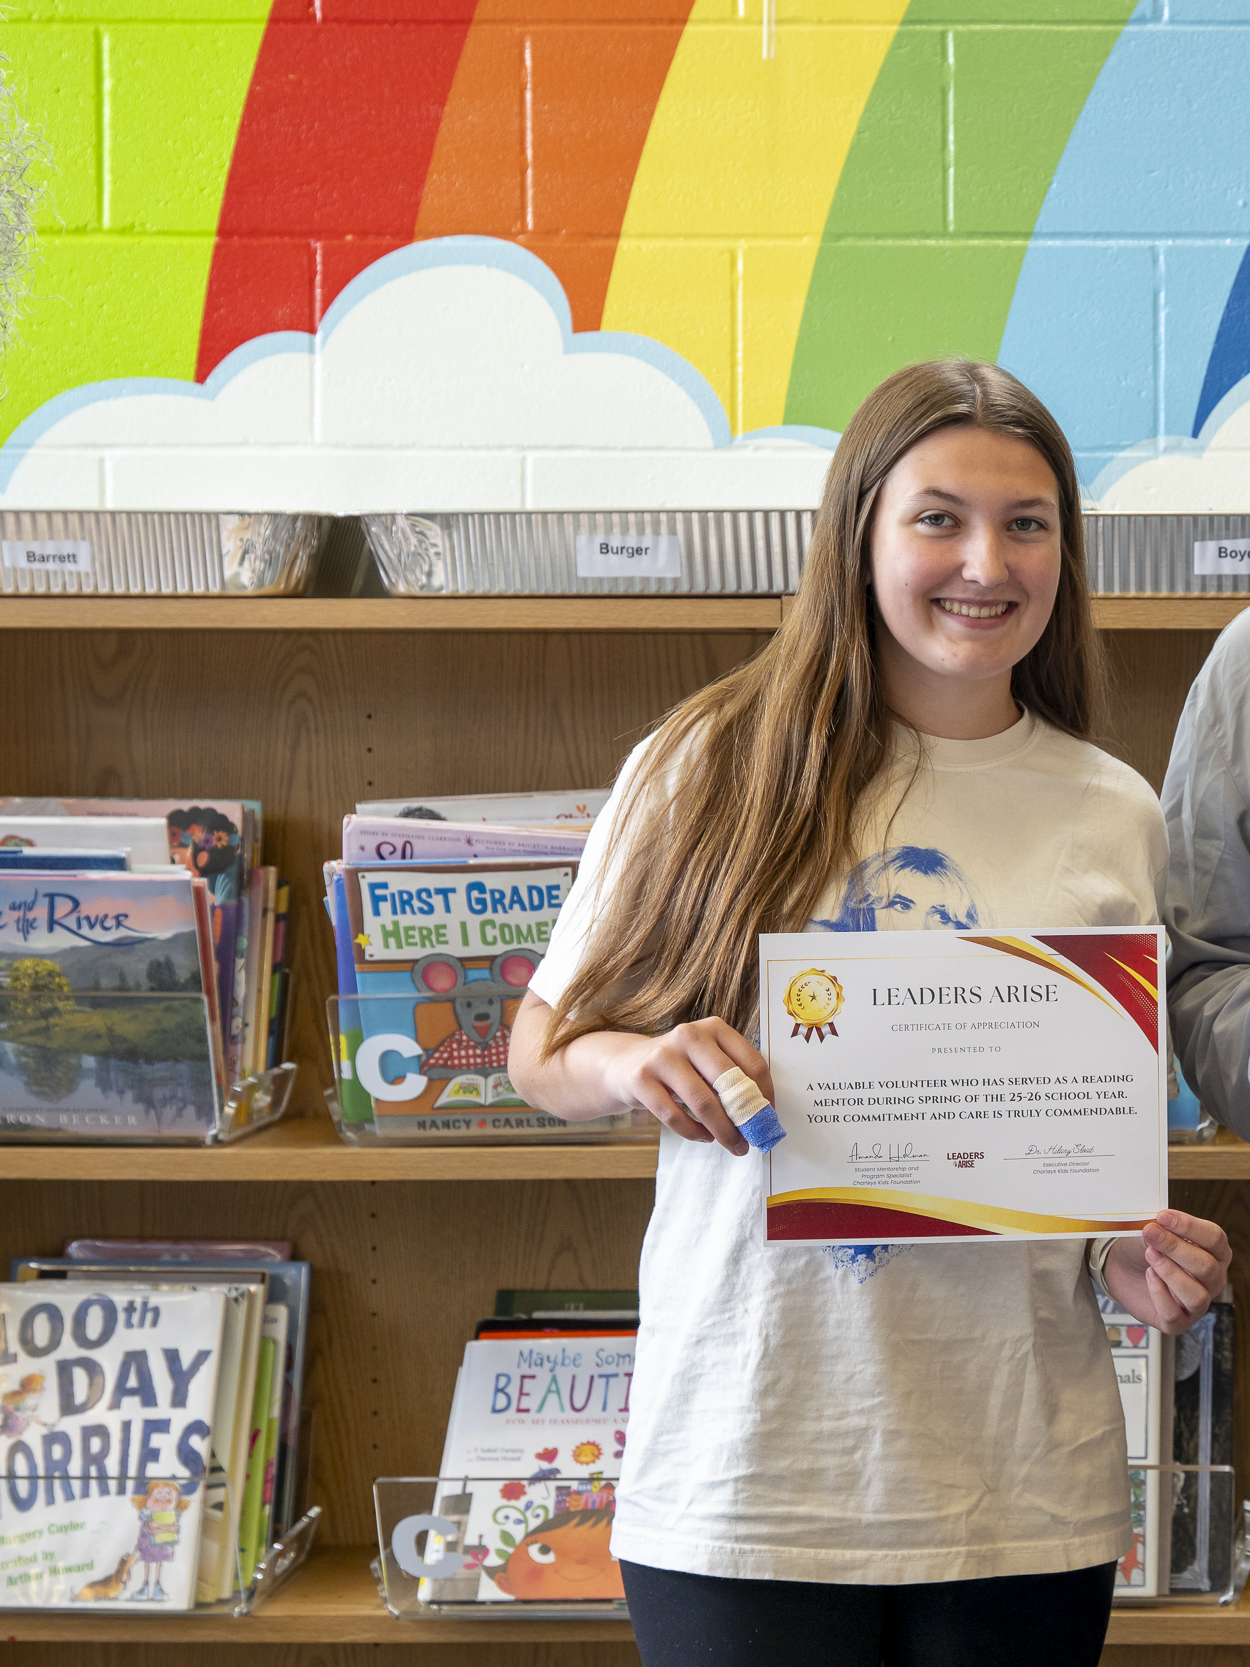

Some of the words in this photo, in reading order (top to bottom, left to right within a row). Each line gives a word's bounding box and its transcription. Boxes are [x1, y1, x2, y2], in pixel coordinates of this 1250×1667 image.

[26, 550, 78, 564] Barrett
[599, 543, 649, 558] Burger
[8, 887, 38, 914] and
[367, 881, 456, 917] FIRST
[465, 881, 562, 915] GRADE
[14, 914, 38, 943] the
[42, 892, 158, 946] River
[381, 919, 449, 950] HERE
[459, 921, 469, 947] I
[872, 985, 981, 1005] LEADERS
[989, 984, 1057, 1003] ARISE
[891, 1022, 952, 1031] CERTIFICATE
[954, 1022, 967, 1030] OF
[970, 1020, 1039, 1029] APPRECIATION
[355, 1033, 428, 1101] C
[817, 1081, 874, 1090] VALUABLE
[877, 1079, 947, 1088] VOLUNTEER
[950, 1078, 978, 1086] WHO
[982, 1077, 1004, 1086] HAS
[1007, 1076, 1051, 1085] SERVED
[1053, 1075, 1067, 1084] AS
[1081, 1074, 1133, 1083] READING
[813, 1097, 864, 1107] MENTOR
[867, 1095, 914, 1105] DURING
[918, 1094, 961, 1104] SPRING
[964, 1094, 979, 1103] OF
[982, 1093, 1005, 1102] THE
[1008, 1091, 1041, 1102] 25-26
[1044, 1091, 1092, 1100] SCHOOL
[1095, 1090, 1127, 1099] YEAR.
[59, 1114, 139, 1125] BECKER
[416, 1119, 472, 1131] NANCY
[491, 1116, 567, 1129] CARLSON
[806, 1113, 839, 1123] YOUR
[842, 1112, 926, 1122] COMMITMENT
[929, 1111, 955, 1120] AND
[958, 1110, 989, 1119] CARE
[992, 1110, 1002, 1118] IS
[1005, 1109, 1041, 1118] TRULY
[1045, 1106, 1137, 1117] COMMENDABLE.
[849, 1142, 884, 1162] Amanda
[946, 1152, 984, 1160] LEADERS
[1025, 1145, 1041, 1156] Dr.
[957, 1160, 975, 1168] ARISE
[0, 1293, 161, 1366] 100th
[517, 1348, 582, 1373] Maybe
[595, 1348, 636, 1368] Som
[56, 1347, 214, 1418] DAY
[3, 1418, 212, 1513] ORRIES
[47, 1520, 86, 1535] Cuyler
[41, 1550, 55, 1562] by
[391, 1514, 465, 1579] C
[6, 1571, 44, 1588] Arthur
[48, 1559, 94, 1577] Howard
